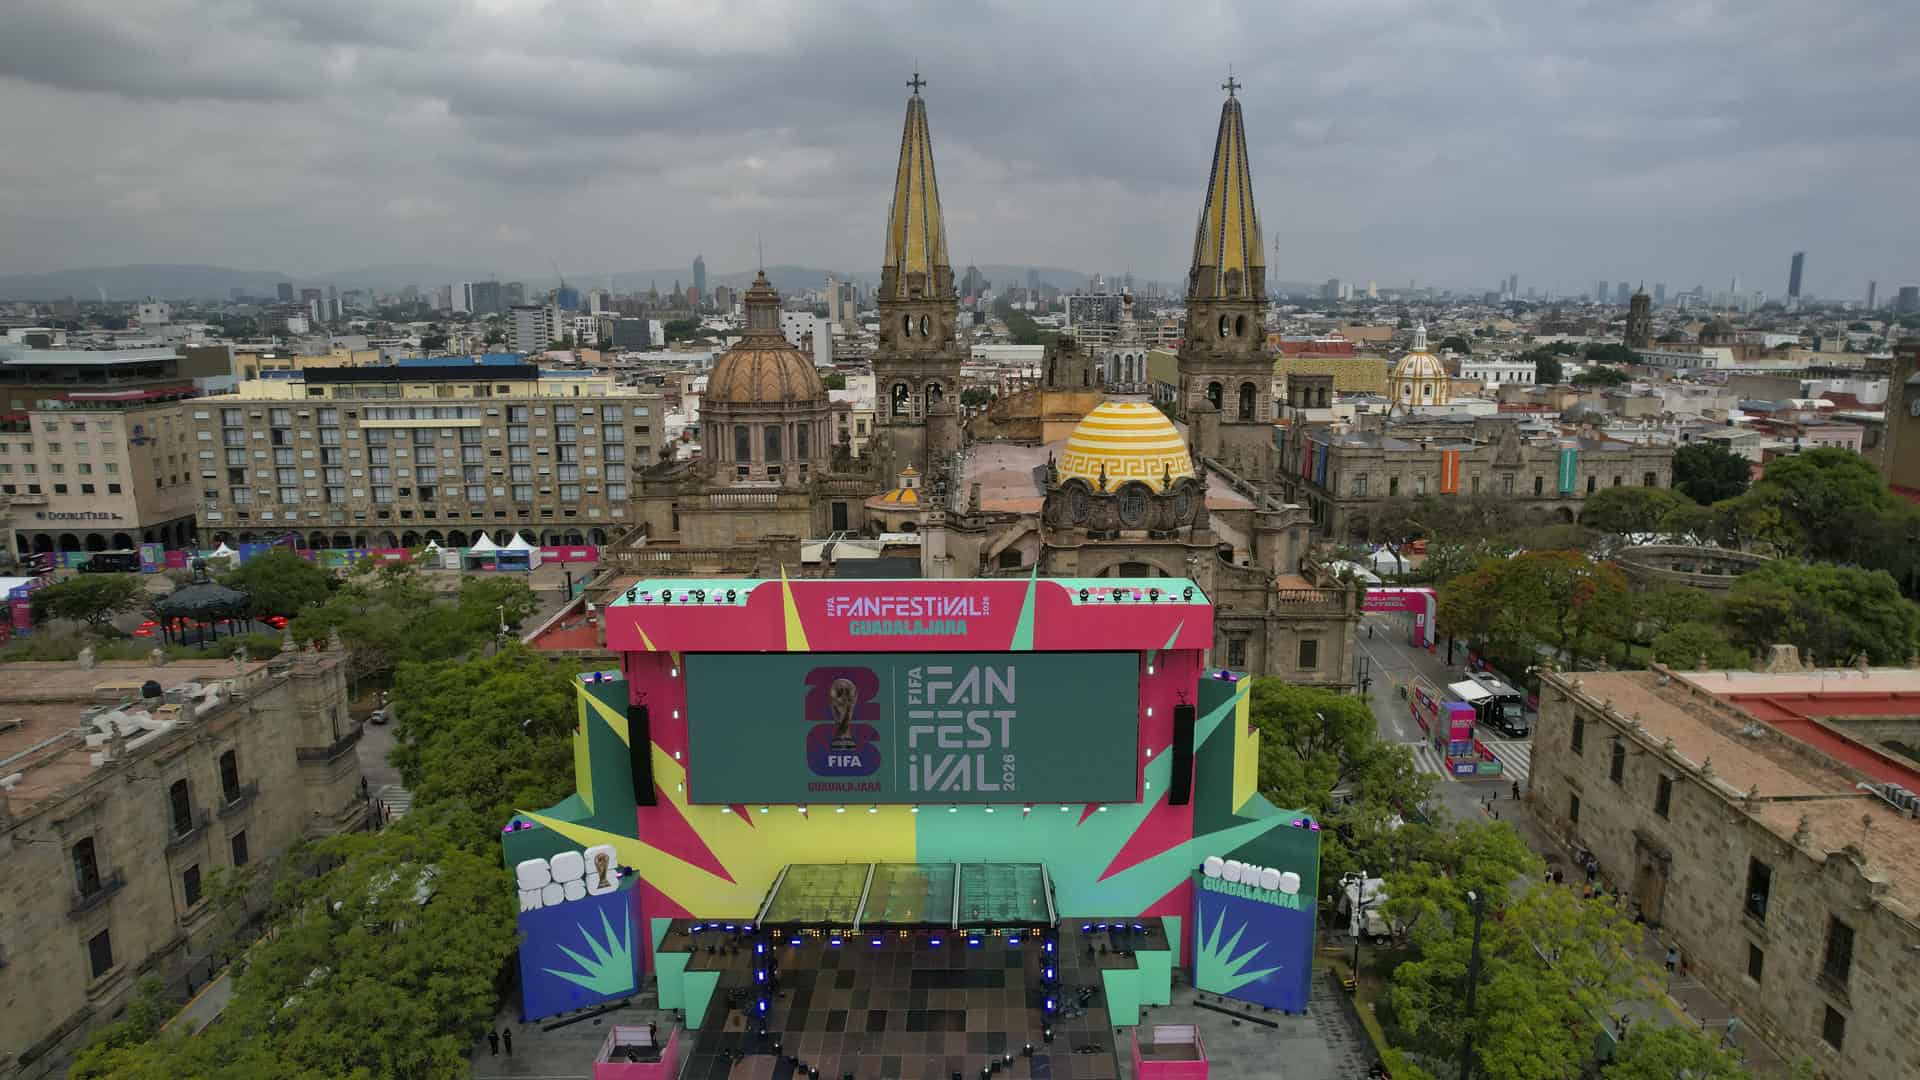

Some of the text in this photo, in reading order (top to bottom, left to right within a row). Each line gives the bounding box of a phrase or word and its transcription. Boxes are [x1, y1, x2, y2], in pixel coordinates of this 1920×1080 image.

[849, 620, 967, 635] GUADALAJARA
[908, 666, 1016, 705] FIFA FAN
[908, 710, 1017, 749] FEST
[828, 755, 862, 768] FIFA
[1003, 754, 1016, 792] 2026
[1203, 877, 1300, 911] GUADALAJARA
